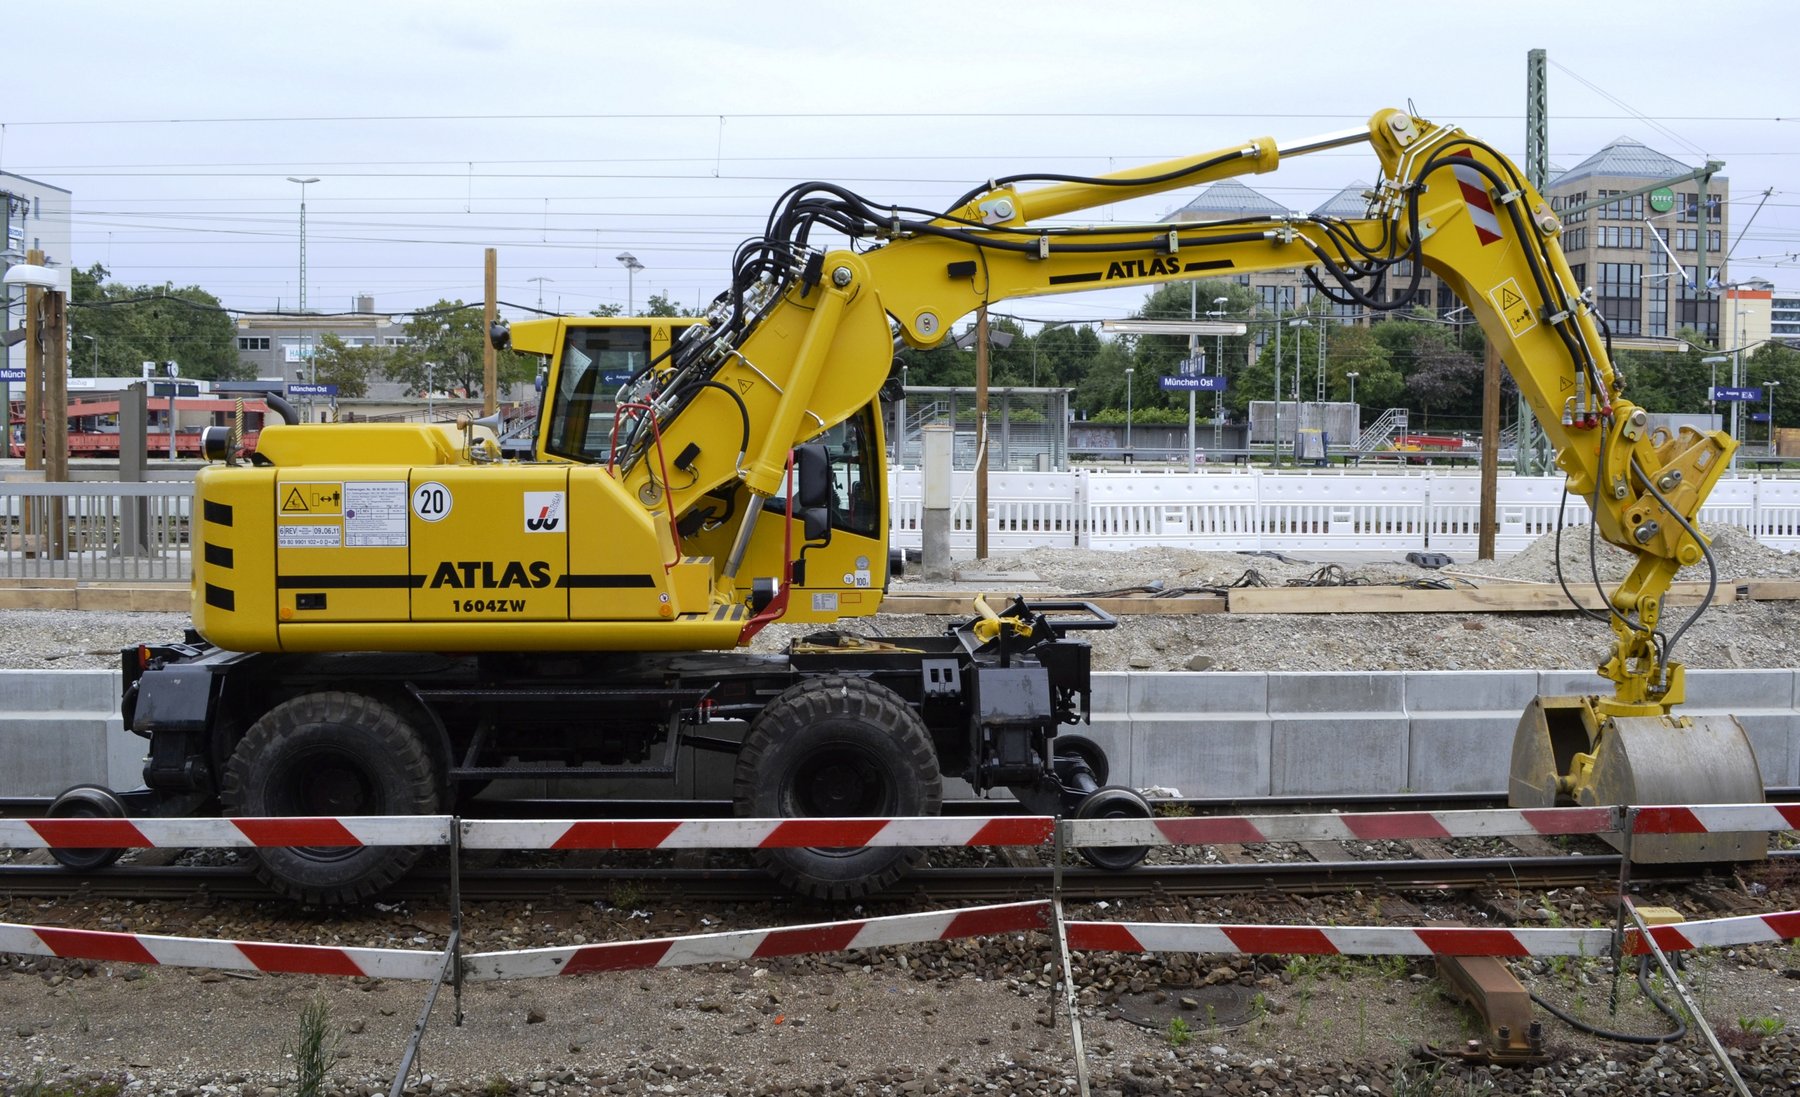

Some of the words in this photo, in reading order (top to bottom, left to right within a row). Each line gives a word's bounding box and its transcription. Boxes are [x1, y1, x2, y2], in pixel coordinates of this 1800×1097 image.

[1106, 257, 1180, 280] ATLAS
[290, 385, 316, 393] München
[316, 385, 327, 393] Ost
[1164, 377, 1199, 387] München
[1200, 378, 1213, 387] Ost
[420, 489, 444, 514] 20
[429, 560, 552, 588] ATLAS
[856, 577, 867, 586] 100
[453, 599, 526, 613] 1604ZW
